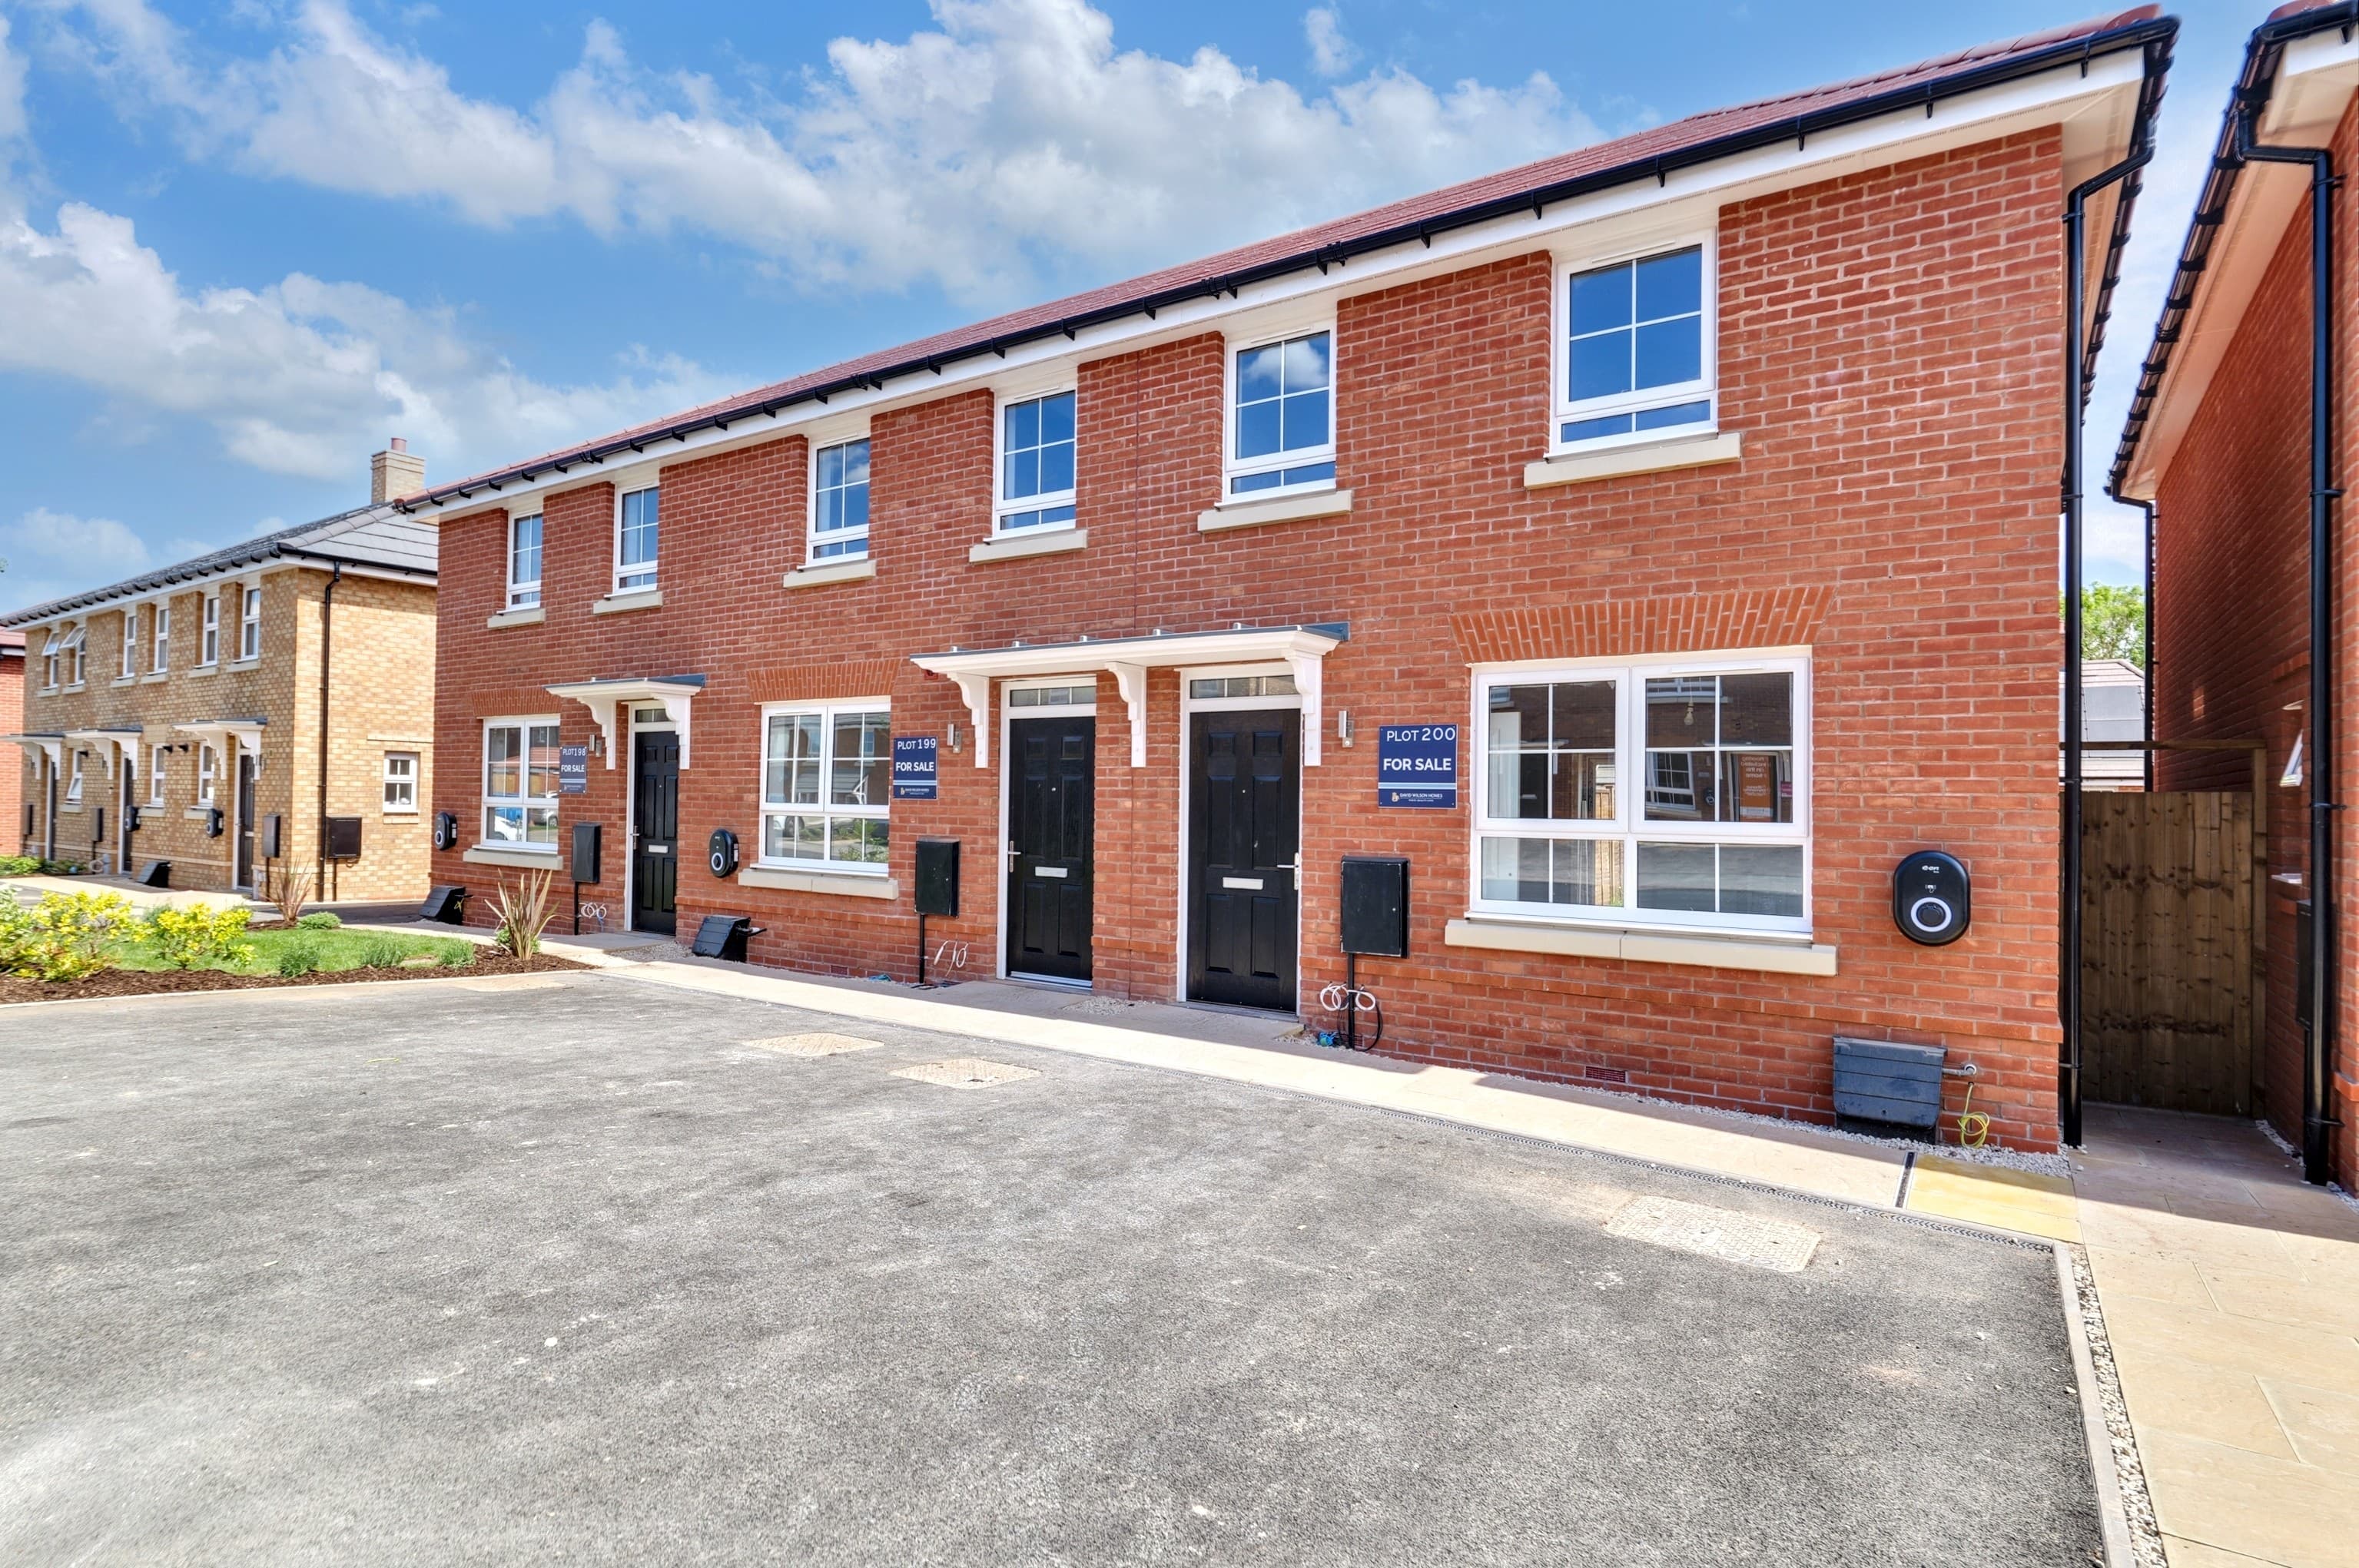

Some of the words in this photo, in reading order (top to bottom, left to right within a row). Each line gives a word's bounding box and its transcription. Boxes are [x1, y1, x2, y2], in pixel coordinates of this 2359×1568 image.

[1387, 731, 1419, 741] PLOT
[1422, 728, 1455, 741] 200
[897, 741, 917, 750] PLOT
[917, 738, 936, 749] 199
[574, 748, 586, 756] 198
[896, 761, 912, 771] FOR
[913, 761, 934, 771] SALE
[1383, 758, 1412, 771] FOR
[1415, 758, 1452, 771] SALE
